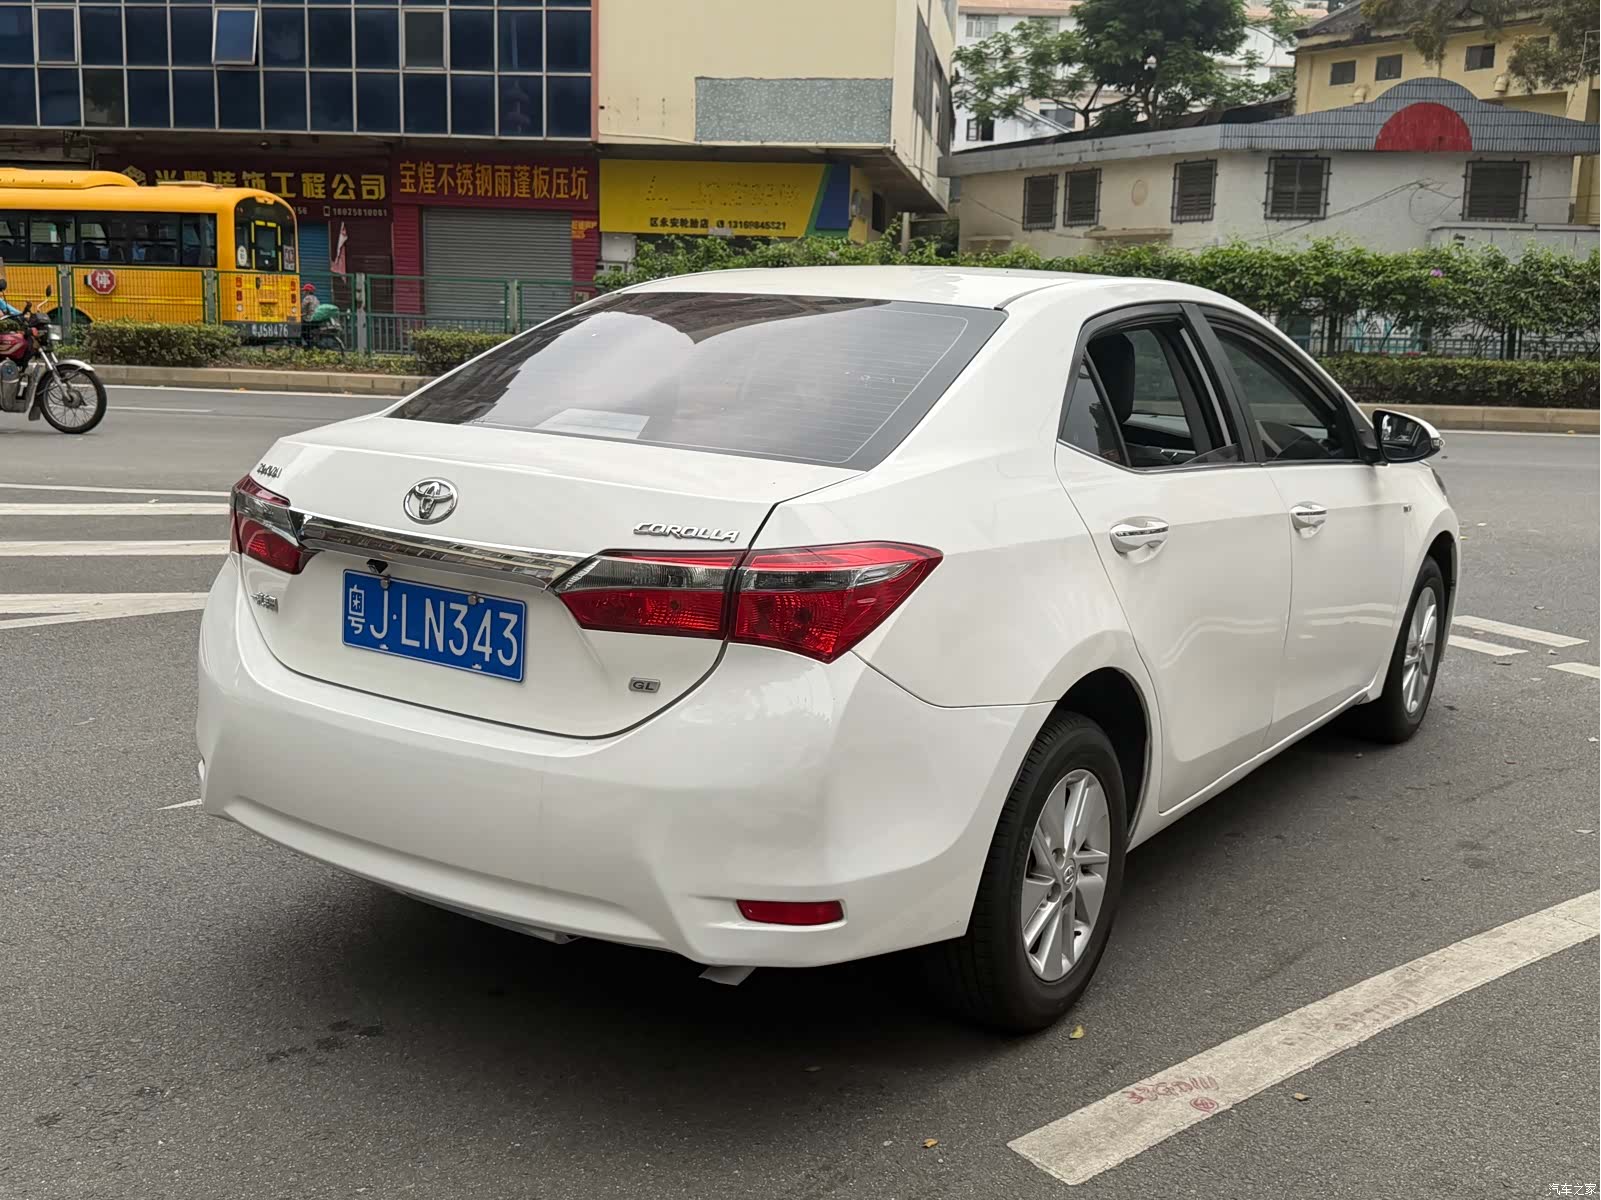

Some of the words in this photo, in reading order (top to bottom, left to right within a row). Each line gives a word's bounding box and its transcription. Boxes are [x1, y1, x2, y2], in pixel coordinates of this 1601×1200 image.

[400, 161, 589, 200] 宝煌不锈钢雨蓬板压坑
[633, 522, 740, 543] COROLLA
[632, 681, 655, 691] GL
